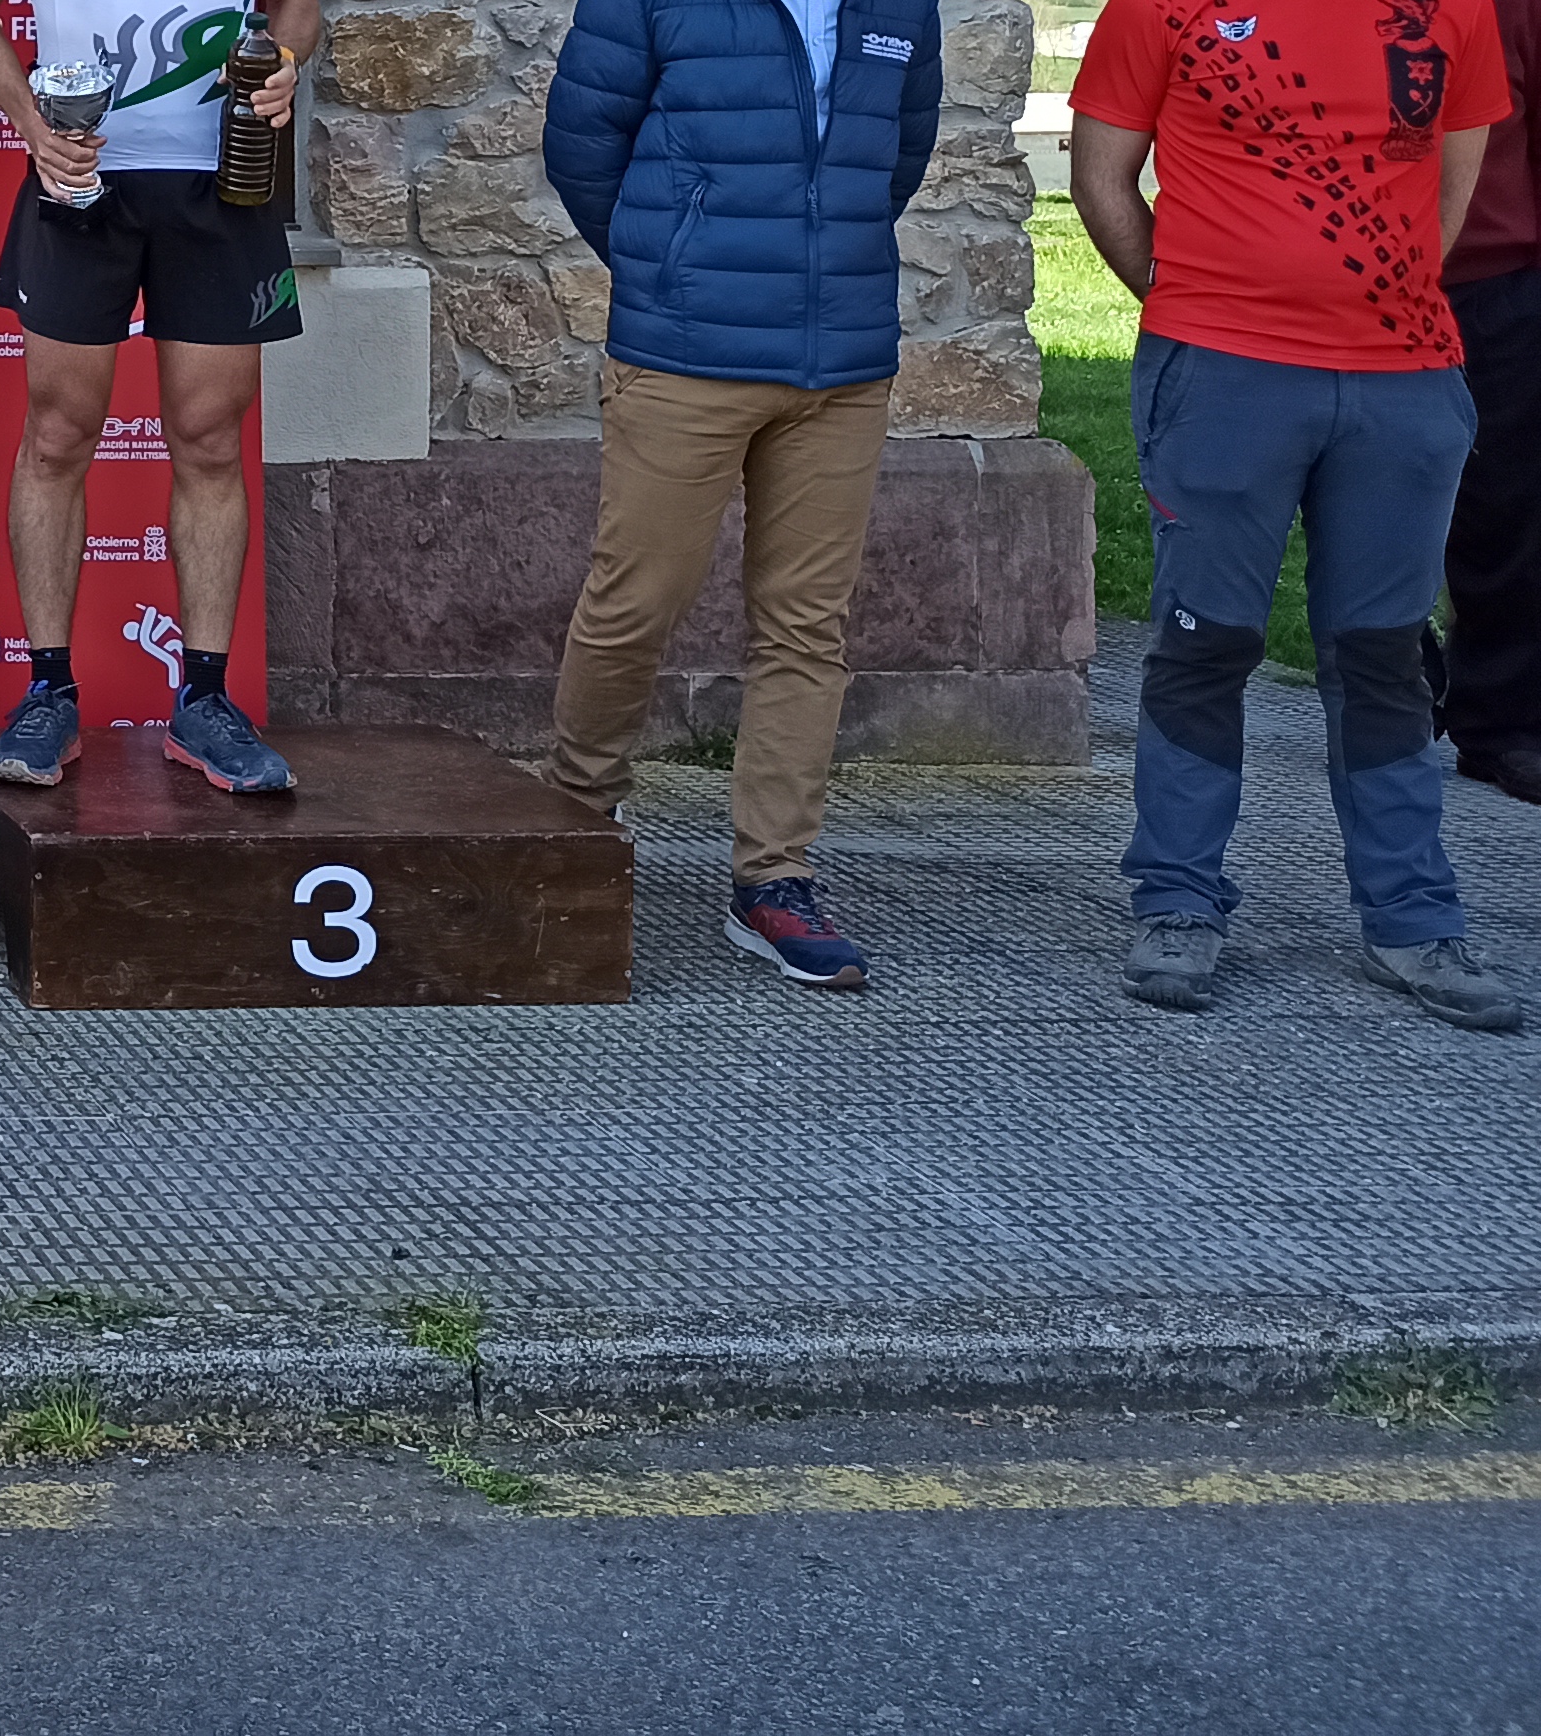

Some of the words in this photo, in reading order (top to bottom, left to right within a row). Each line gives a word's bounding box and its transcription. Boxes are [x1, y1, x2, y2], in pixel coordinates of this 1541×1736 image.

[2, 130, 13, 138] DE
[98, 440, 130, 449] RACIÓN
[94, 452, 129, 460] ARROAKO
[86, 536, 139, 547] Gobierno
[94, 550, 139, 561] Navarra
[292, 865, 377, 978] 3
